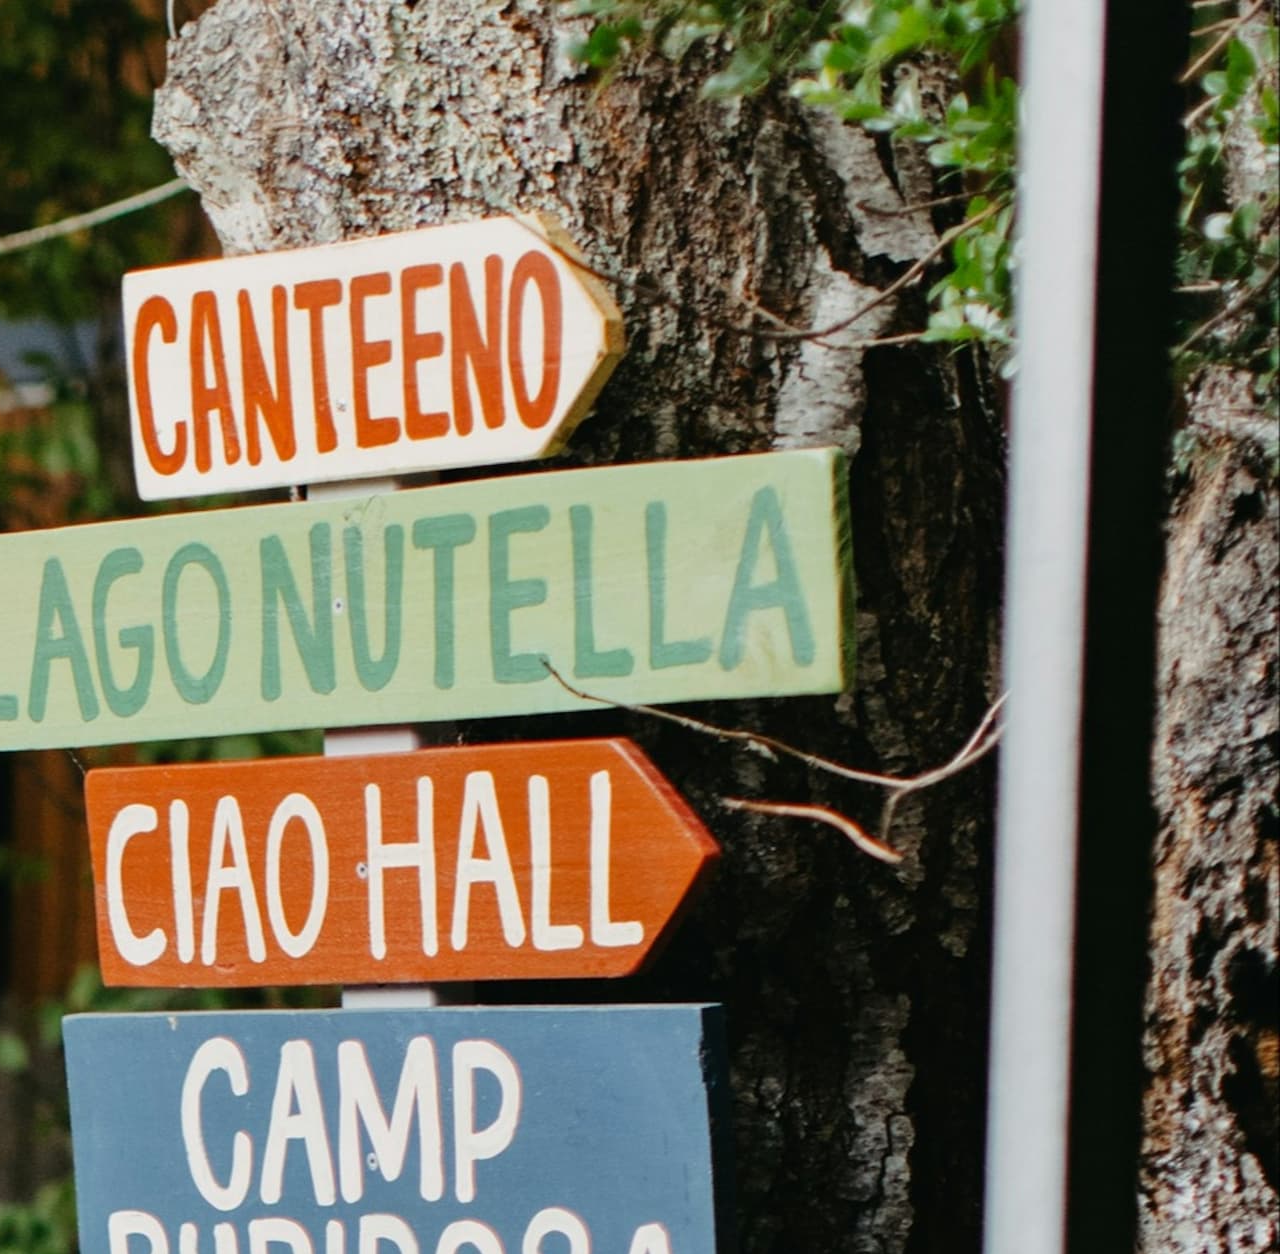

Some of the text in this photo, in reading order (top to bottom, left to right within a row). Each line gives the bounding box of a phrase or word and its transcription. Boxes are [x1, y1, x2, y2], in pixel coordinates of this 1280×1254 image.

[132, 252, 561, 477] CANTEENO
[259, 485, 817, 703] NUTELLA
[105, 770, 645, 967] CIAO HALL
[180, 1034, 523, 1212] CAMP
